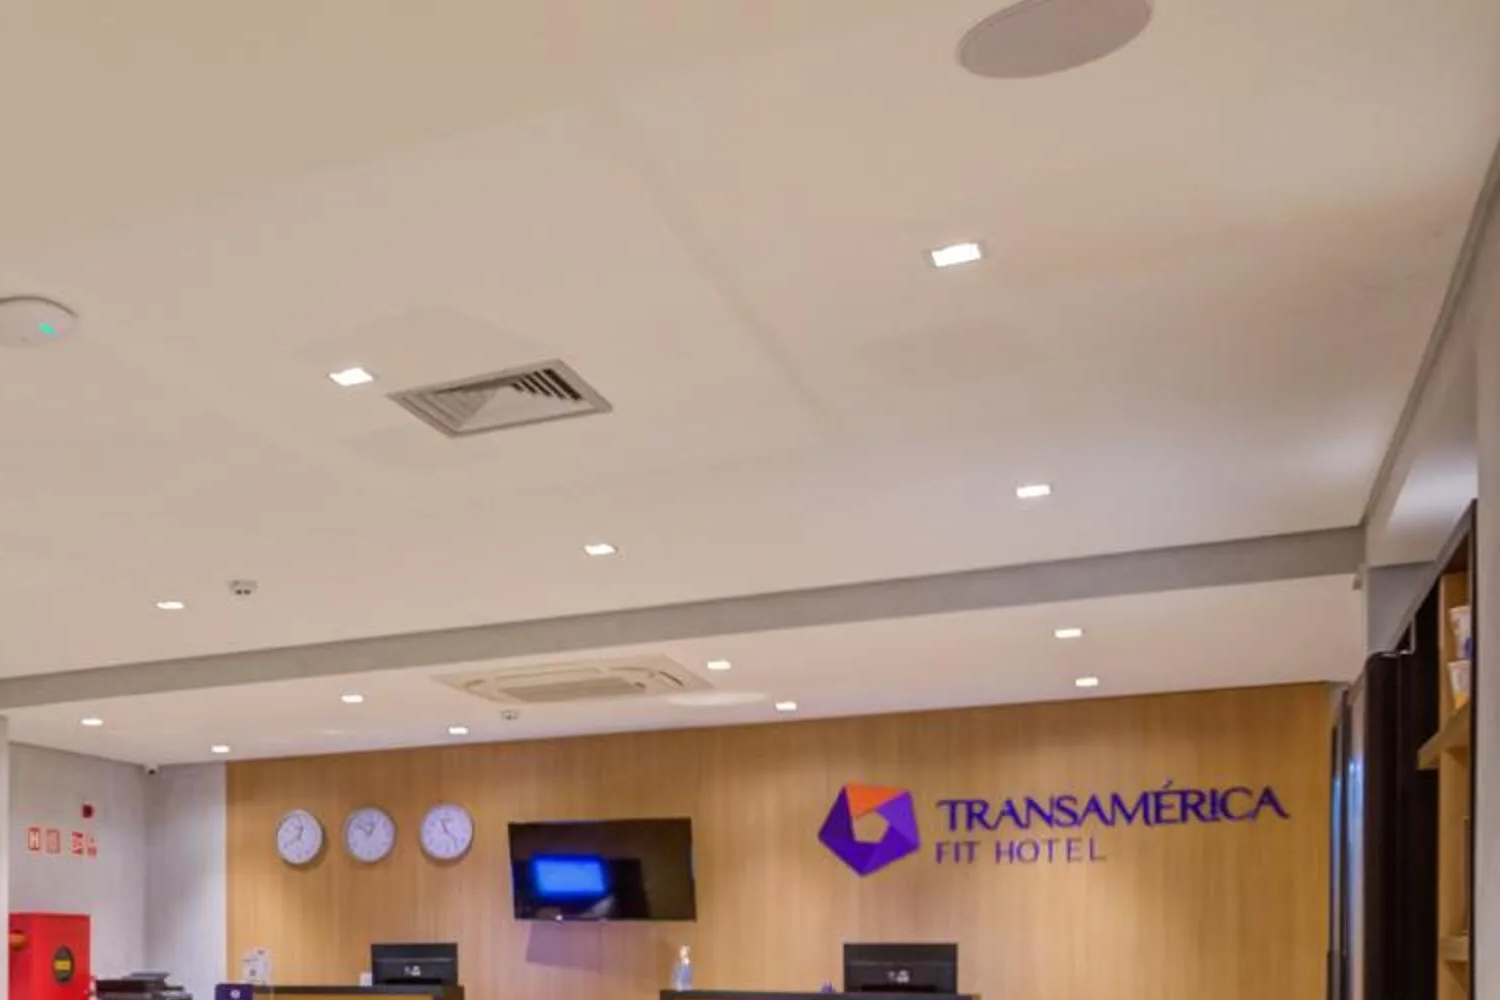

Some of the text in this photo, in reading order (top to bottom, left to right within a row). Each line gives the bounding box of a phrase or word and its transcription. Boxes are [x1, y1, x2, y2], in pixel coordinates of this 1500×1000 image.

[936, 780, 1290, 831] TRANSAMÉRICA
[936, 837, 1107, 865] FIT HOTEL
